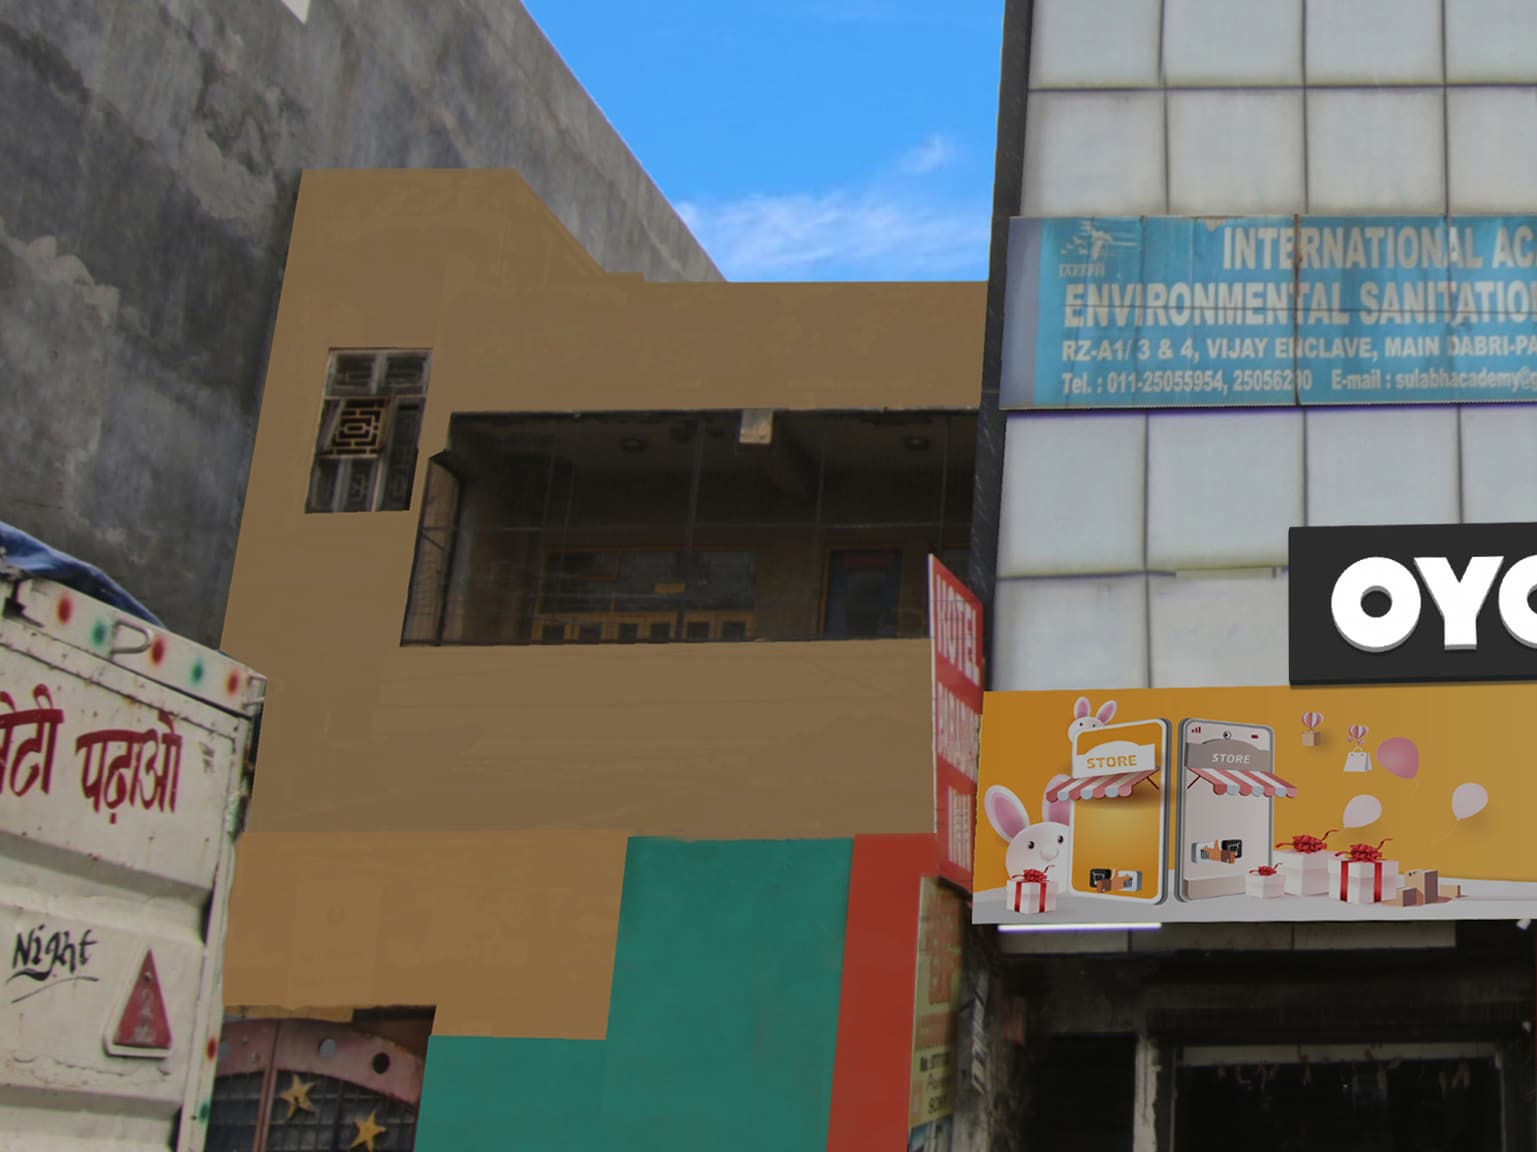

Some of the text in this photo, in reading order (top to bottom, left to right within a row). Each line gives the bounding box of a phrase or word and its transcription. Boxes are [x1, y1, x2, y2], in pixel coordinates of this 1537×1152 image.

[1222, 225, 1483, 270] INTERNATIONAL
[1063, 281, 1350, 328] ENVIRONMENTAL
[1159, 338, 1174, 359] &
[1207, 336, 1267, 359] VIJAY
[1385, 336, 1440, 357] MAIN
[0, 684, 64, 797] ेटी
[1086, 754, 1138, 769] STORE
[1211, 752, 1251, 766] STORE
[7, 923, 98, 982] Night
